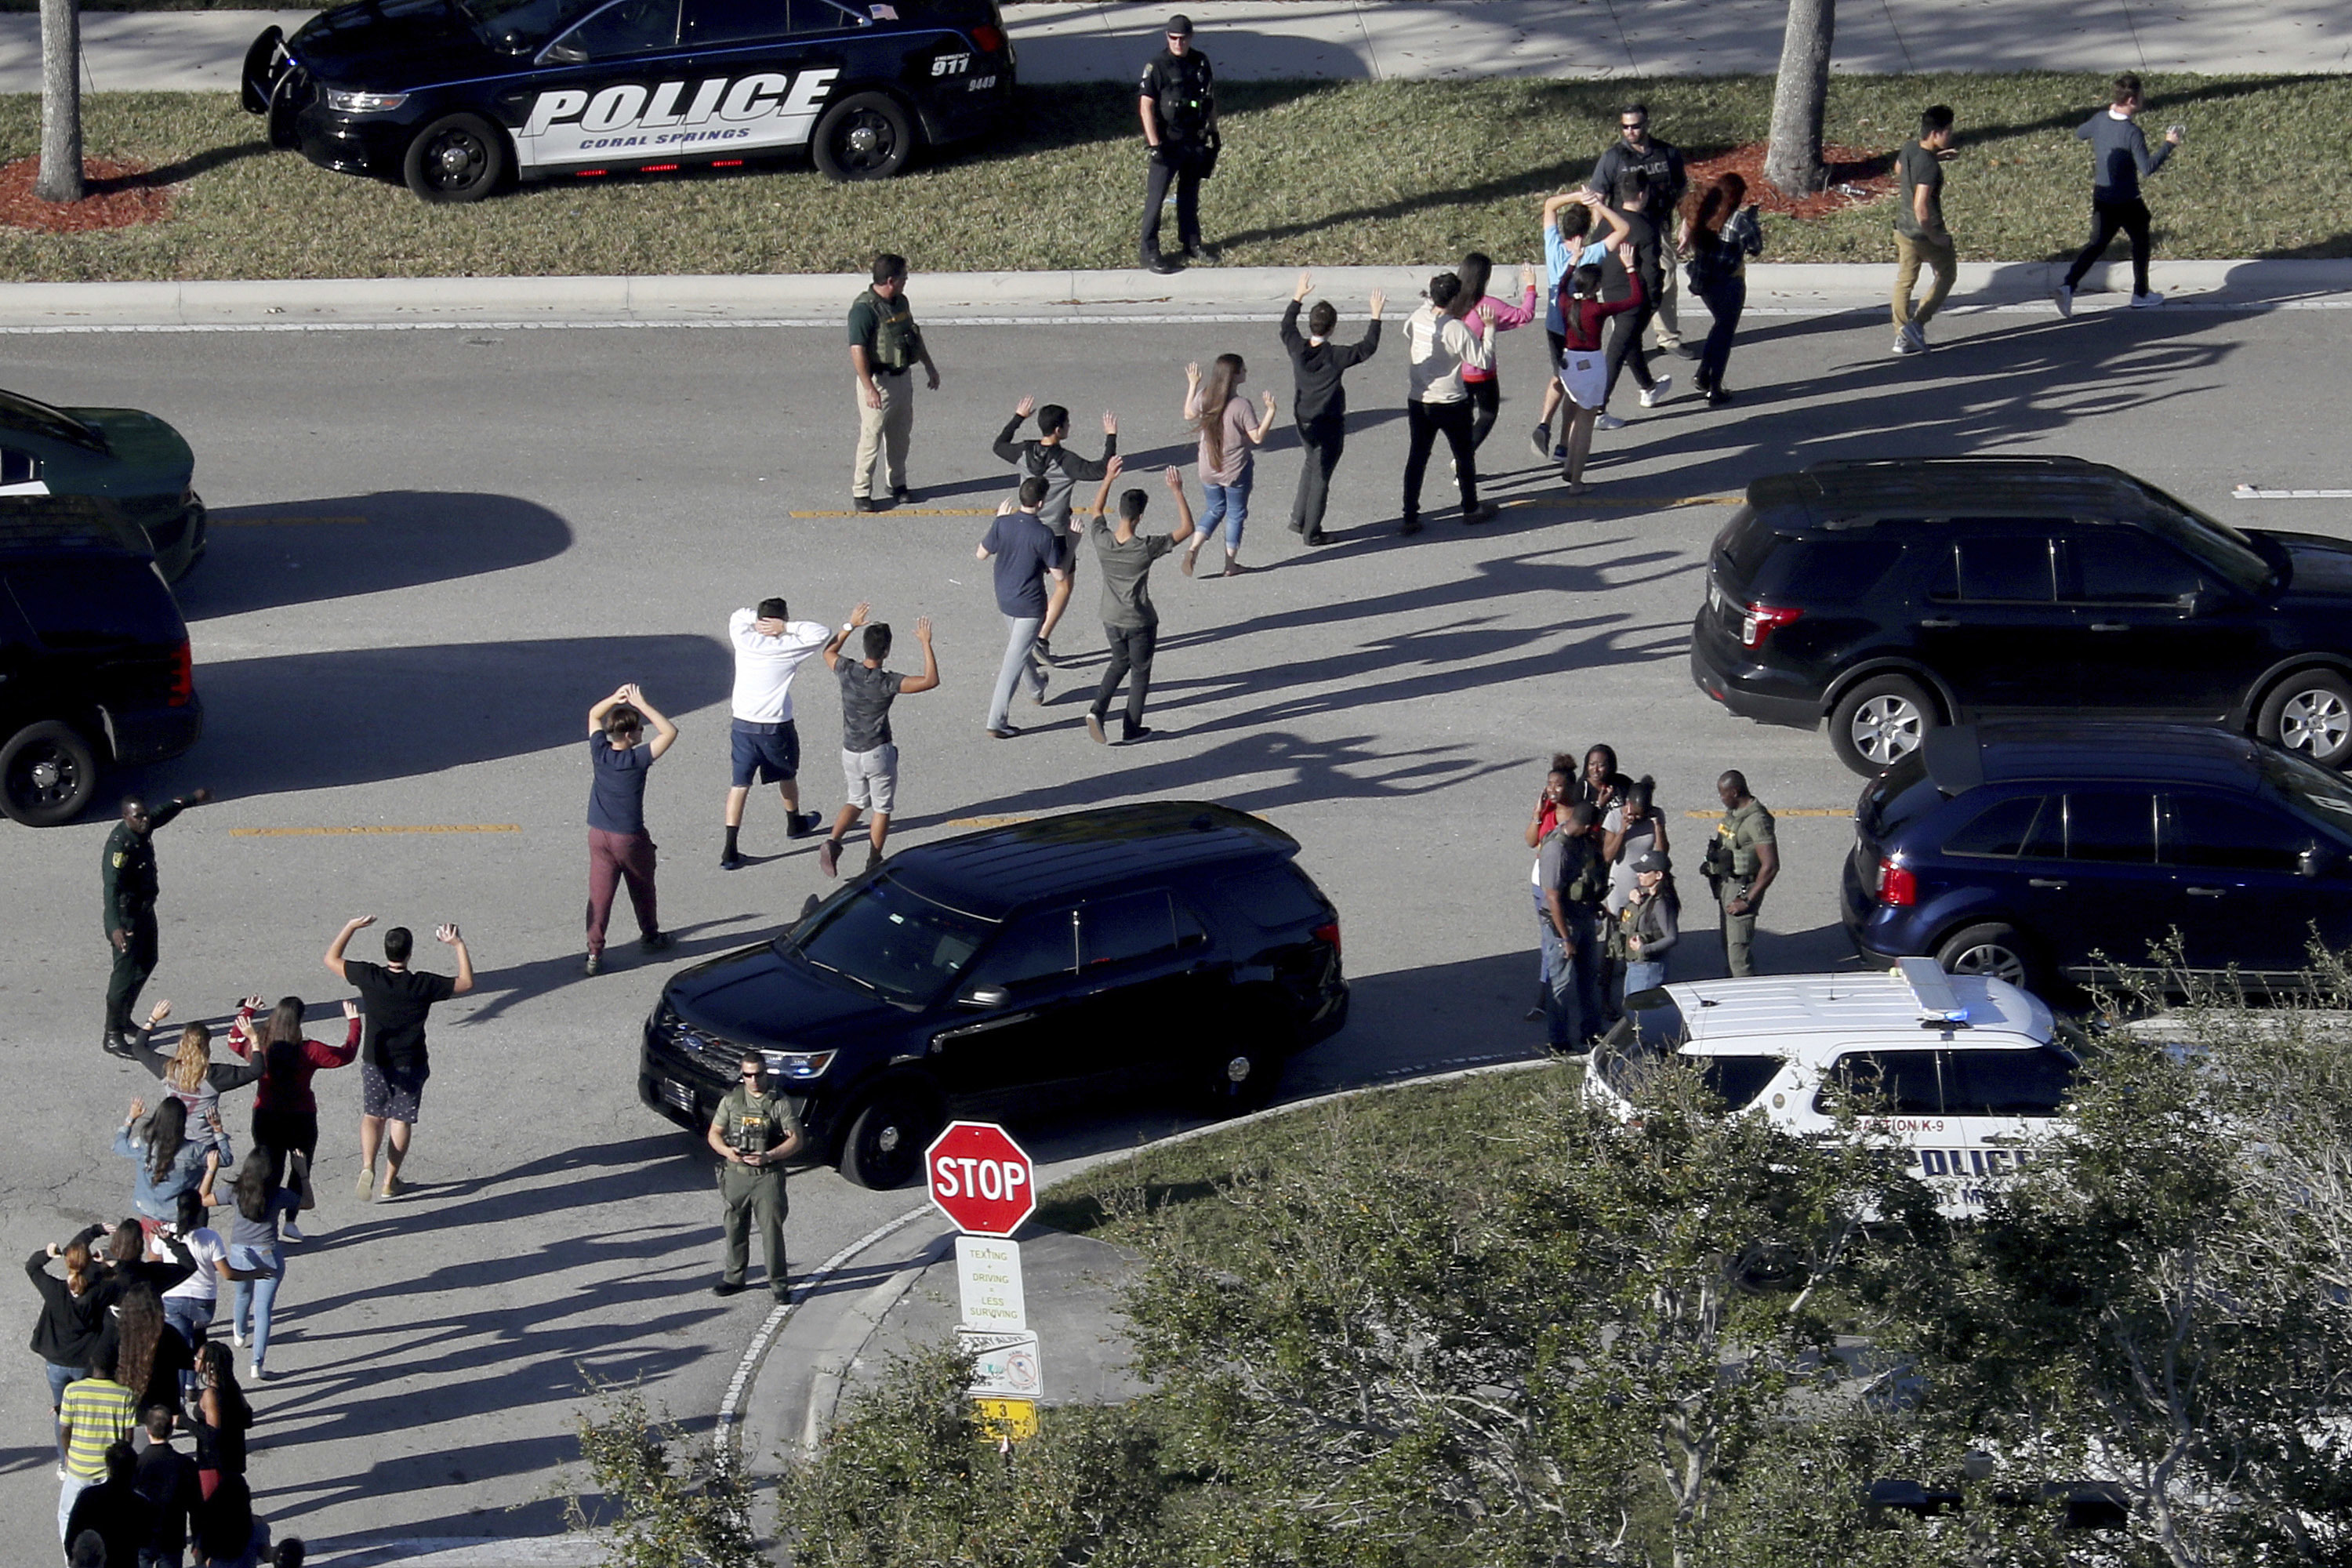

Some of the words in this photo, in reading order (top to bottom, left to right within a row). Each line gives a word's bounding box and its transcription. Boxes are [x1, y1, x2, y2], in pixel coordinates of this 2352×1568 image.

[931, 58, 969, 76] 911
[518, 68, 840, 138] POLICE
[579, 136, 648, 150] CORAL
[655, 128, 751, 145] SPRINGS
[1922, 1120, 1945, 1132] K-9
[936, 1156, 1026, 1201] STOP
[970, 1249, 1008, 1261] TEXTING
[972, 1273, 1009, 1283] DRIVING
[982, 1298, 1004, 1306] LESS
[970, 1307, 1018, 1319] SURVIVING
[999, 1404, 1007, 1417] 3
